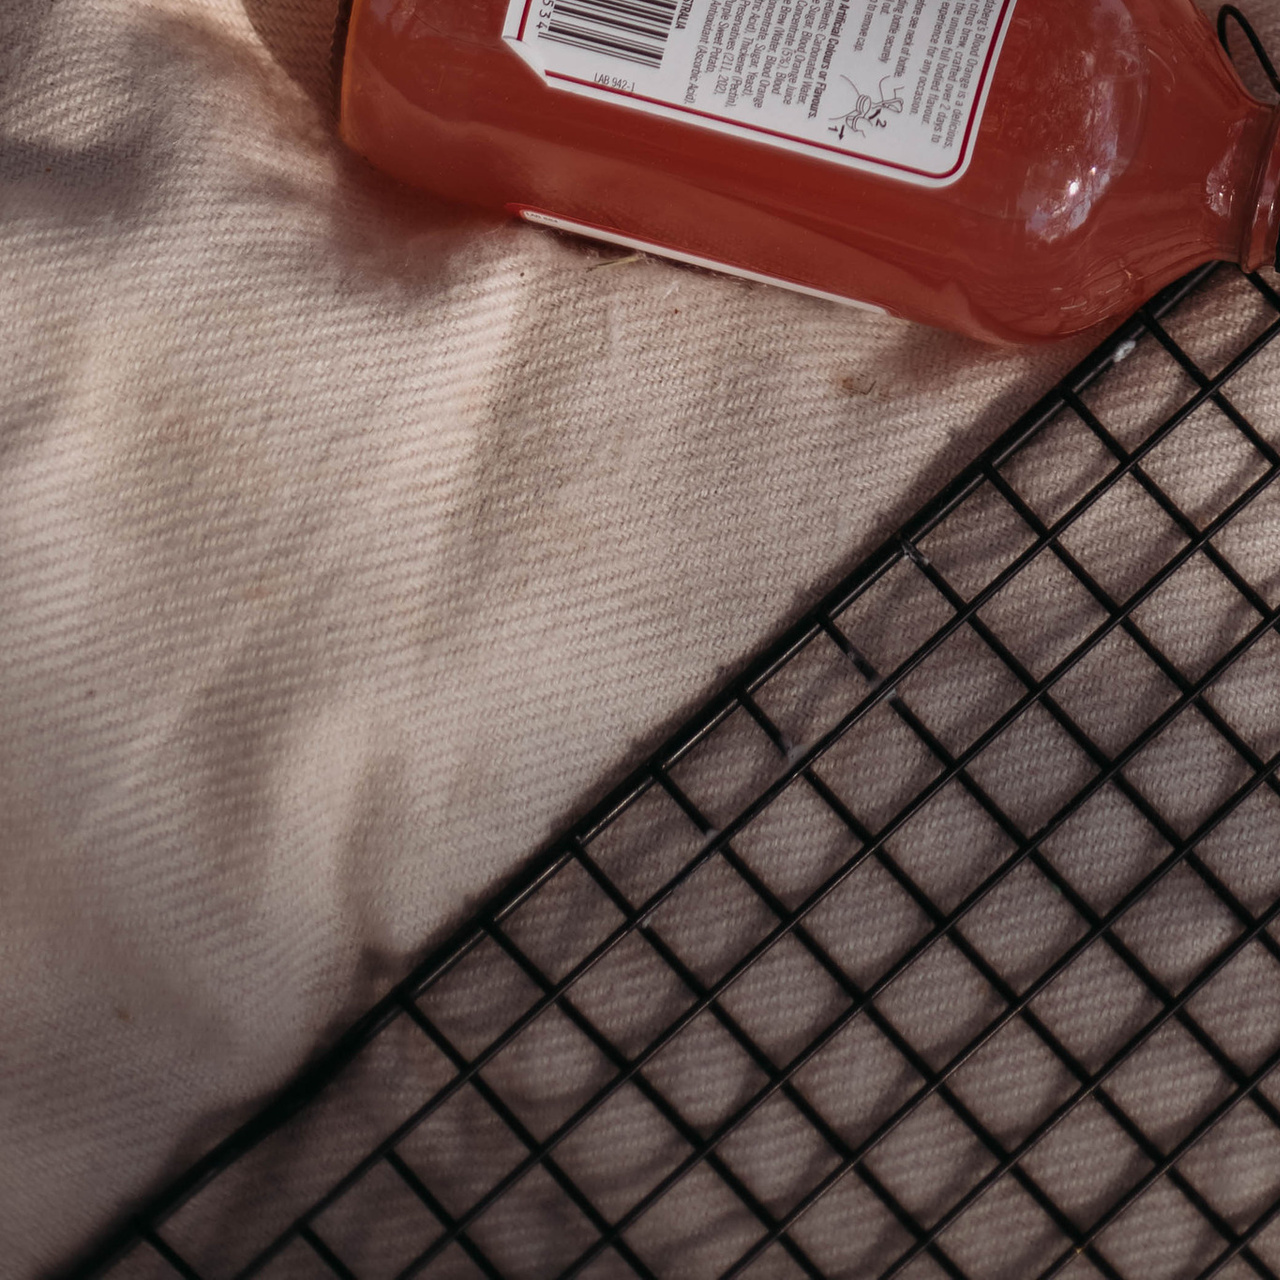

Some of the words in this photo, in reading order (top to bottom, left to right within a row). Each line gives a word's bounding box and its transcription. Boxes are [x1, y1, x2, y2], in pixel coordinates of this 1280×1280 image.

[776, 5, 792, 26] Brew
[802, 3, 821, 29] Sugar,
[830, 2, 850, 38] Artificial
[866, 3, 878, 12] to
[953, 2, 966, 16] the
[964, 2, 979, 27] citrus
[699, 0, 722, 44] Antioxidant
[713, 21, 730, 46] Sweet
[784, 0, 808, 46] Concentrate
[858, 11, 874, 37] remove
[888, 14, 904, 34] bottle
[908, 16, 920, 29] see
[930, 1, 950, 44] experience
[944, 16, 960, 45] unique
[795, 30, 813, 54] Blood
[878, 34, 896, 64] securely
[900, 45, 911, 56] of
[902, 29, 915, 47] neck
[969, 33, 986, 58] Blood
[689, 45, 708, 82] (Ascorbic
[704, 46, 723, 74] Potato,
[734, 37, 754, 75] Thickener
[748, 40, 766, 68] Sugar,
[803, 33, 826, 80] Carbonated
[820, 38, 840, 70] Colours
[926, 45, 939, 58] for
[939, 46, 953, 62] full
[593, 72, 610, 85] LAB
[761, 54, 778, 79] Blood
[784, 52, 806, 84] Orange
[818, 70, 828, 82] or
[919, 59, 932, 76] any
[930, 62, 948, 92] bodied
[947, 51, 964, 82] crafted
[959, 58, 978, 90] Orange
[752, 79, 771, 108] Orange
[771, 72, 787, 96] Blood
[782, 84, 797, 106] Juice
[796, 80, 813, 105] Water,
[942, 83, 954, 102] over
[957, 90, 966, 99] is
[808, 81, 827, 119] Flavours.
[939, 103, 951, 111] 2
[933, 112, 948, 132] days
[930, 134, 942, 144] to
